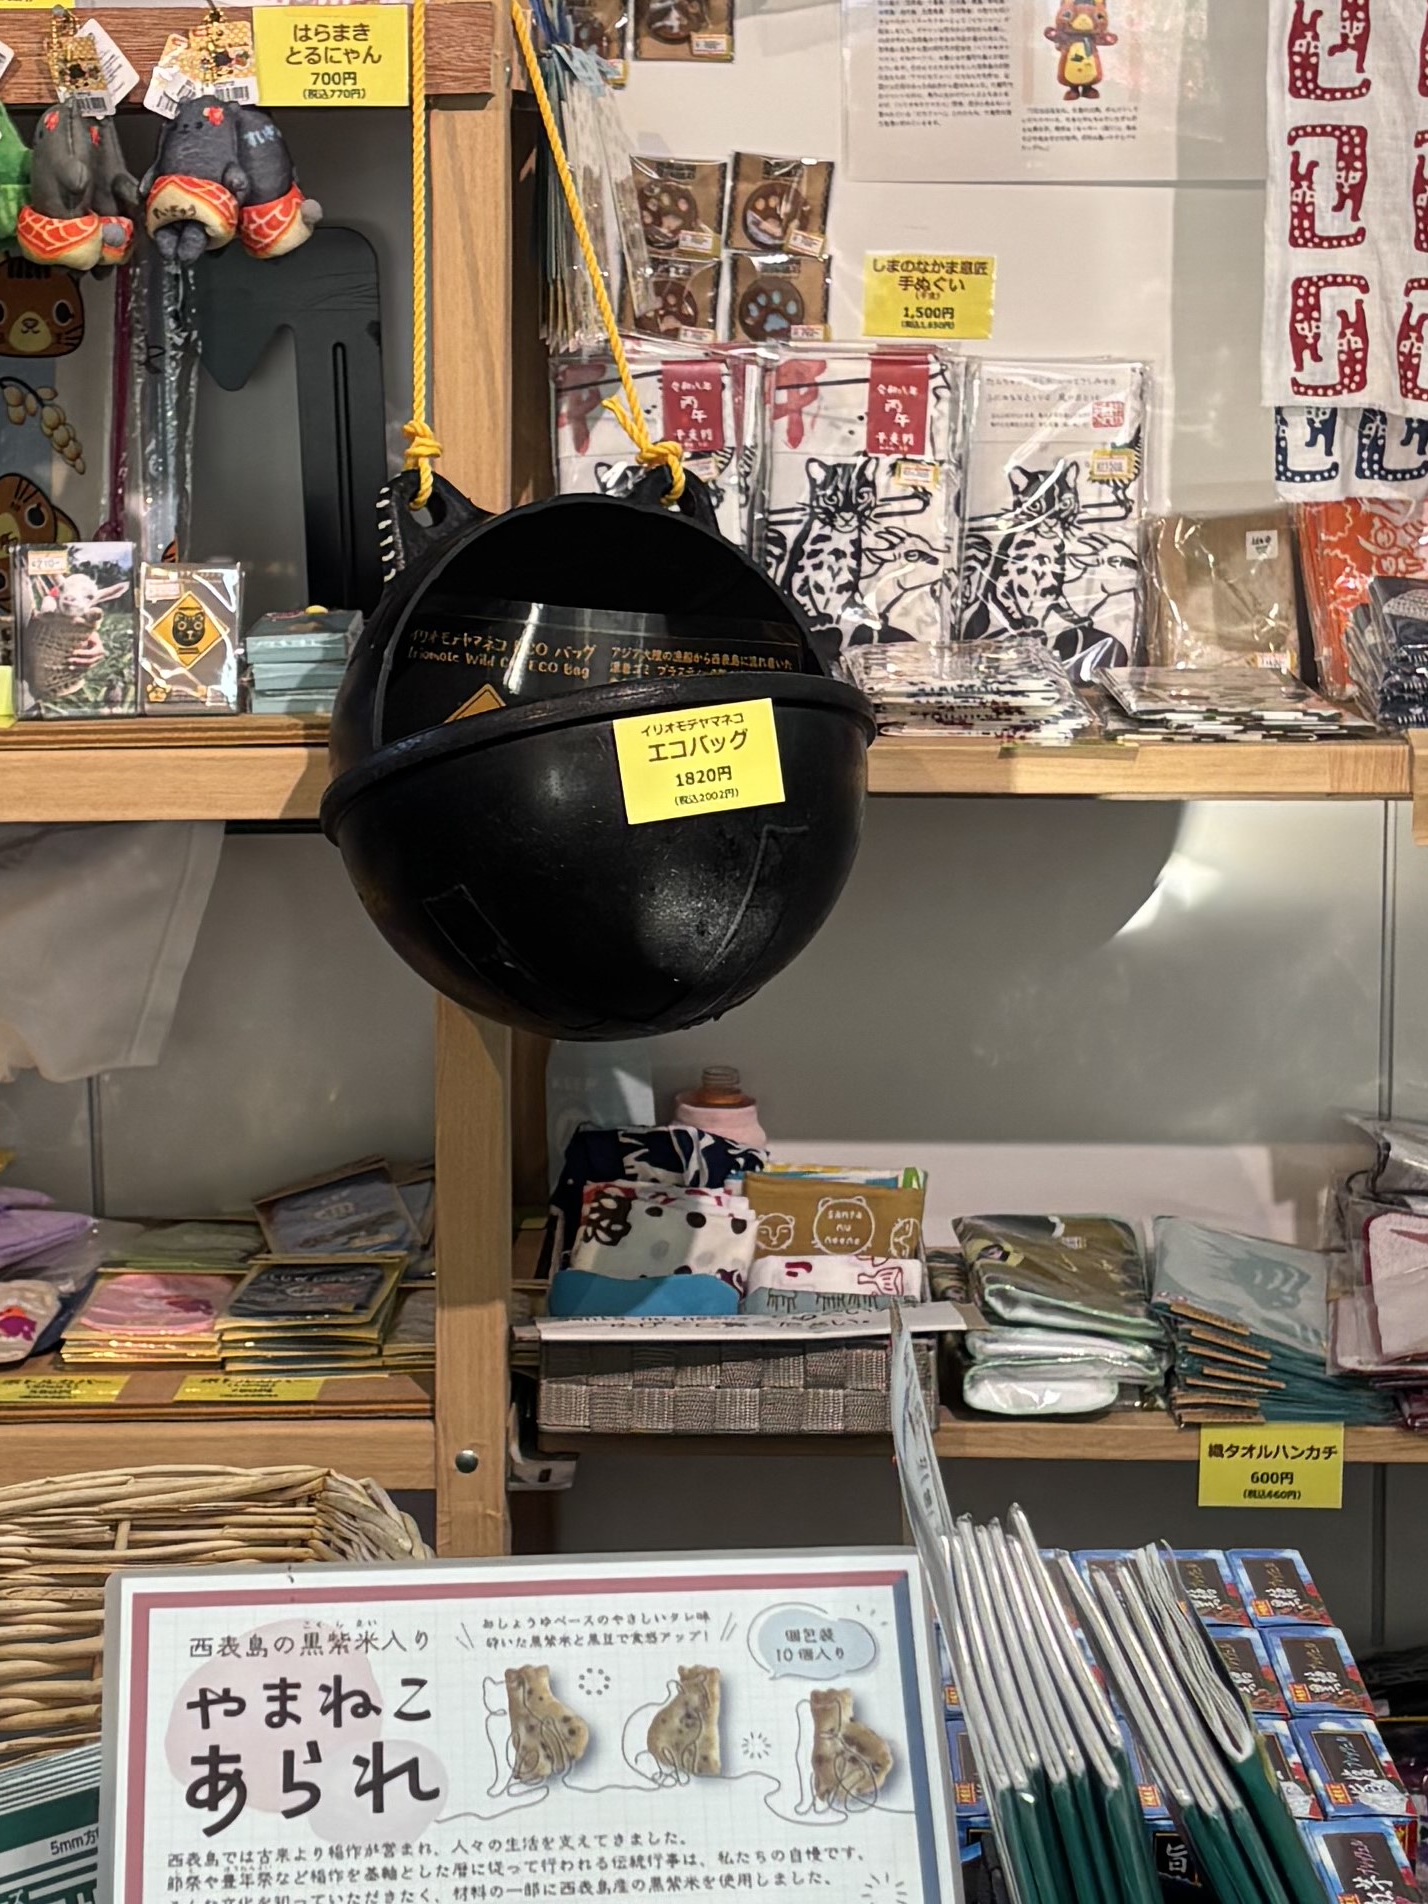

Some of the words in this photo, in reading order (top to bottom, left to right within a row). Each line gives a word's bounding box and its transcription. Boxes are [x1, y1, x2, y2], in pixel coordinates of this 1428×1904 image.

[293, 24, 370, 43] はらまき
[285, 46, 382, 66] とるにゃん
[311, 71, 357, 87] 700円
[303, 88, 366, 101] (税込770円)
[872, 258, 989, 275] しまのなかま意匠
[898, 276, 966, 292] 手ぬぐい
[903, 306, 955, 320] 1,500円
[641, 711, 745, 738] イリオモテヤマネコ
[647, 728, 750, 763] エコバッグ
[675, 764, 733, 788] 1820円
[1208, 1441, 1339, 1464] 織タオルハンカチ
[1250, 1469, 1295, 1487] 600円
[189, 1630, 430, 1659] 西表島の黒紫米入り
[784, 1627, 835, 1645] 個包装
[186, 1674, 432, 1730] やまねこ
[185, 1740, 441, 1838] あられ
